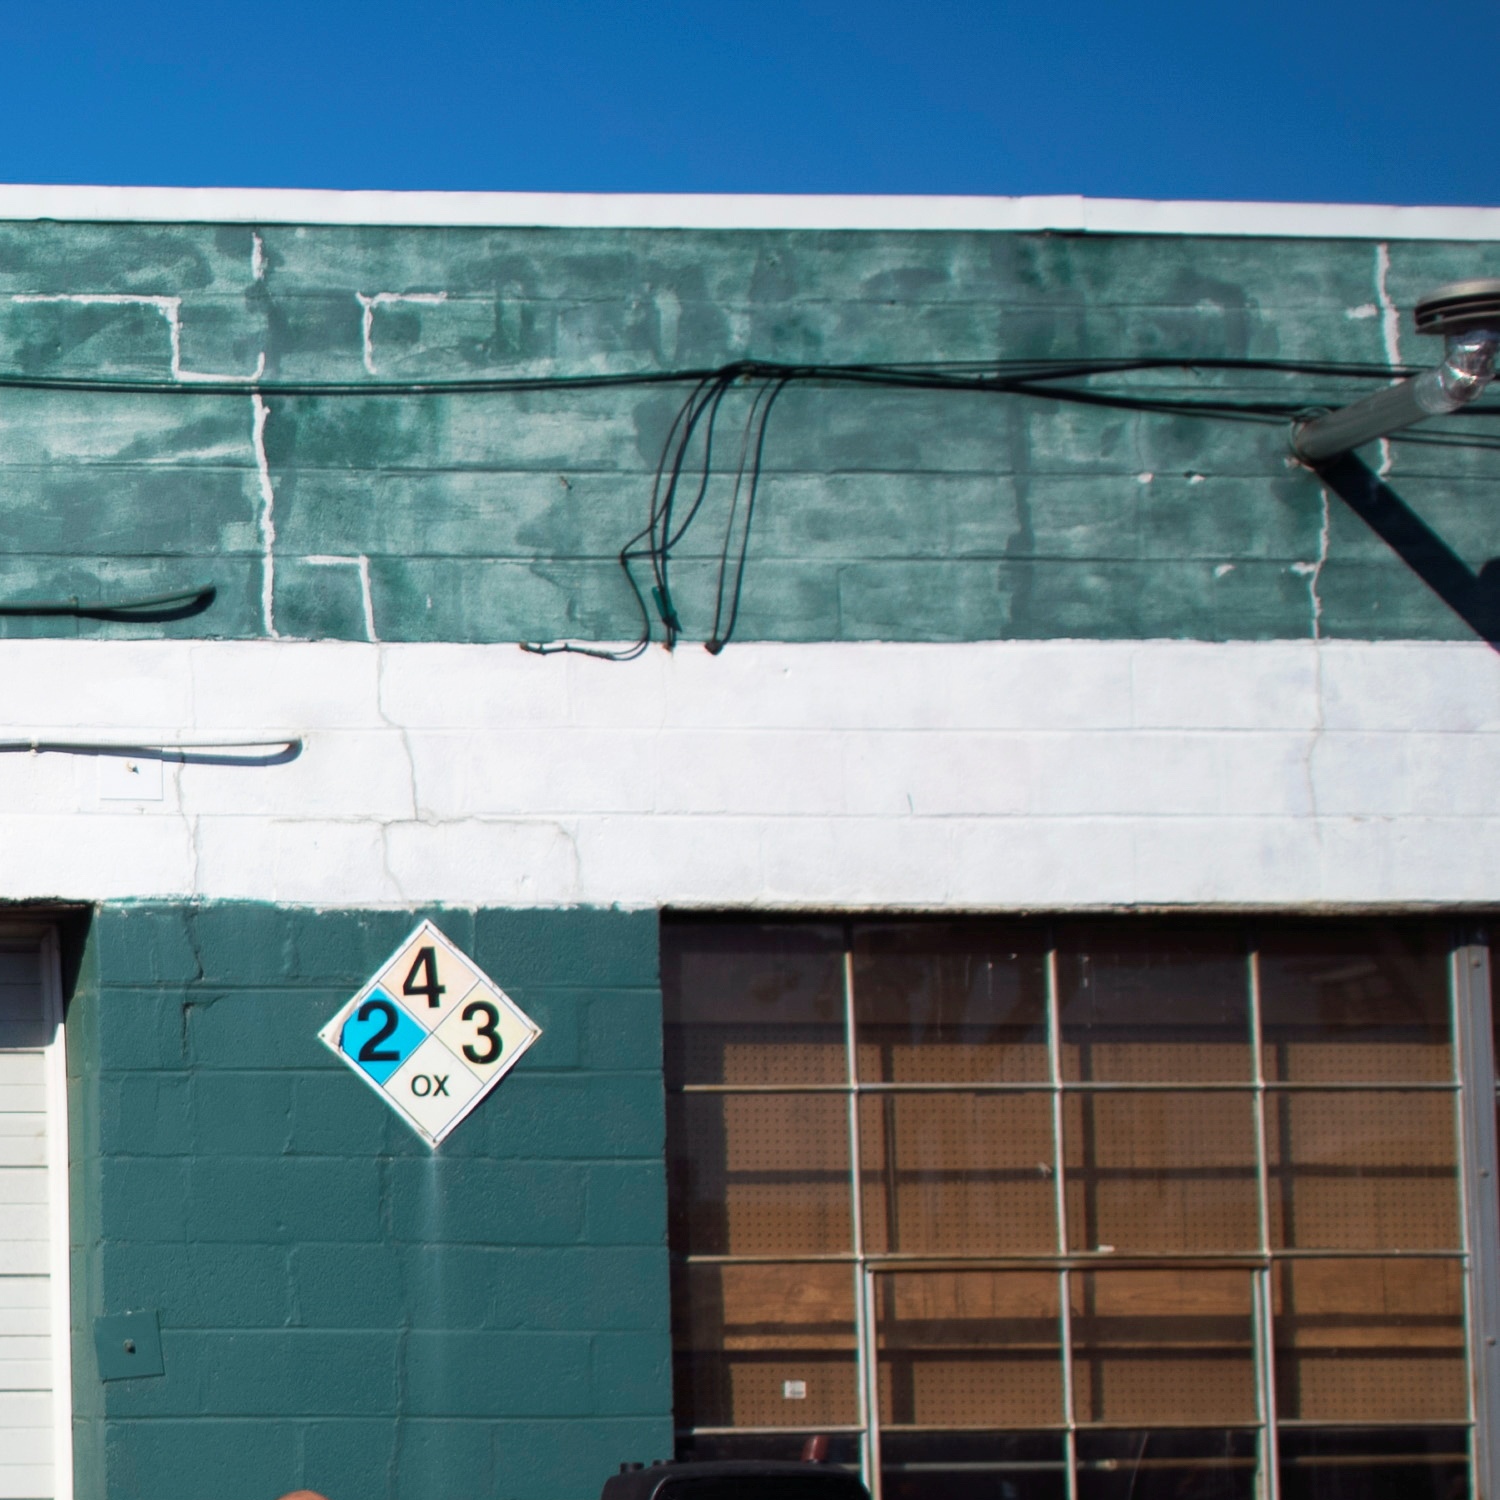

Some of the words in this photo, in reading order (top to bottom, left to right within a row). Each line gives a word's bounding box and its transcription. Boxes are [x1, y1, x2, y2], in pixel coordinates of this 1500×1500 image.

[403, 946, 446, 1008] 4
[357, 1000, 400, 1062] 2
[462, 1001, 502, 1064] 3
[411, 1075, 449, 1097] OX
